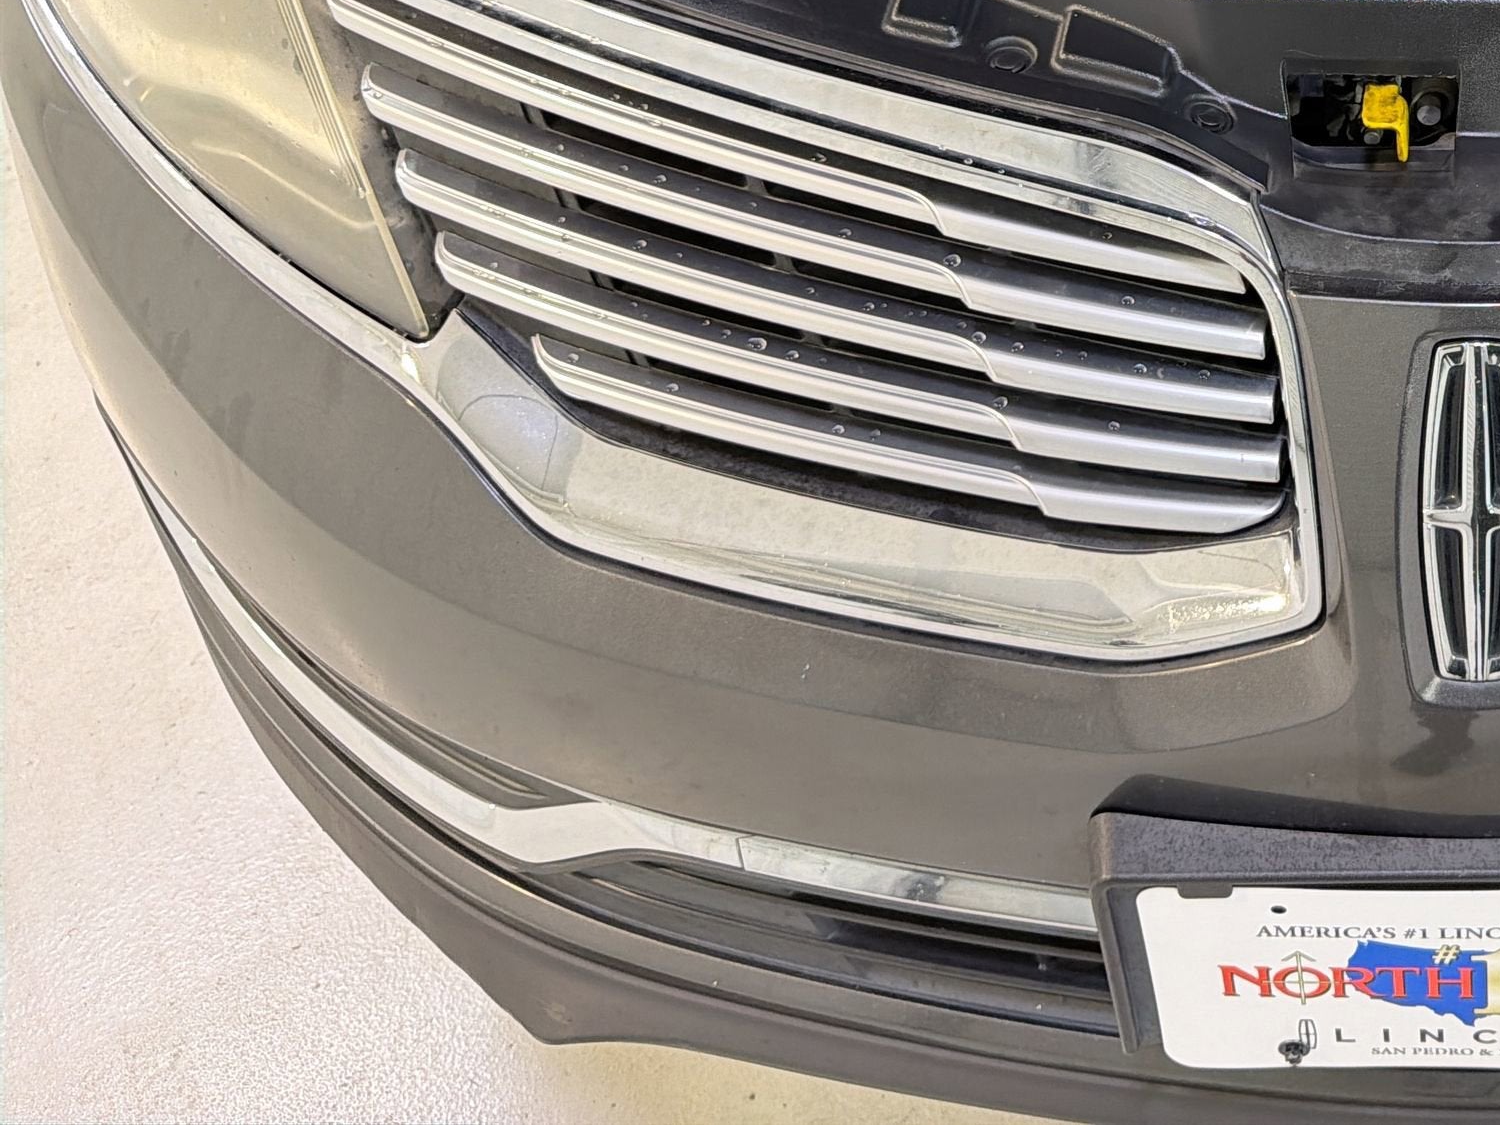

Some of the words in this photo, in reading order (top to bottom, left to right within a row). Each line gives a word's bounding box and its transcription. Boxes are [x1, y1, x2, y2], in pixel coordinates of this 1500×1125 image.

[1255, 925, 1396, 940] AMERICA'S
[1403, 927, 1429, 940] #1
[1217, 964, 1476, 1000] NORTH
[1371, 1046, 1407, 1056] SAN
[1412, 1047, 1474, 1057] PEDRO
[1479, 1048, 1493, 1057] &
